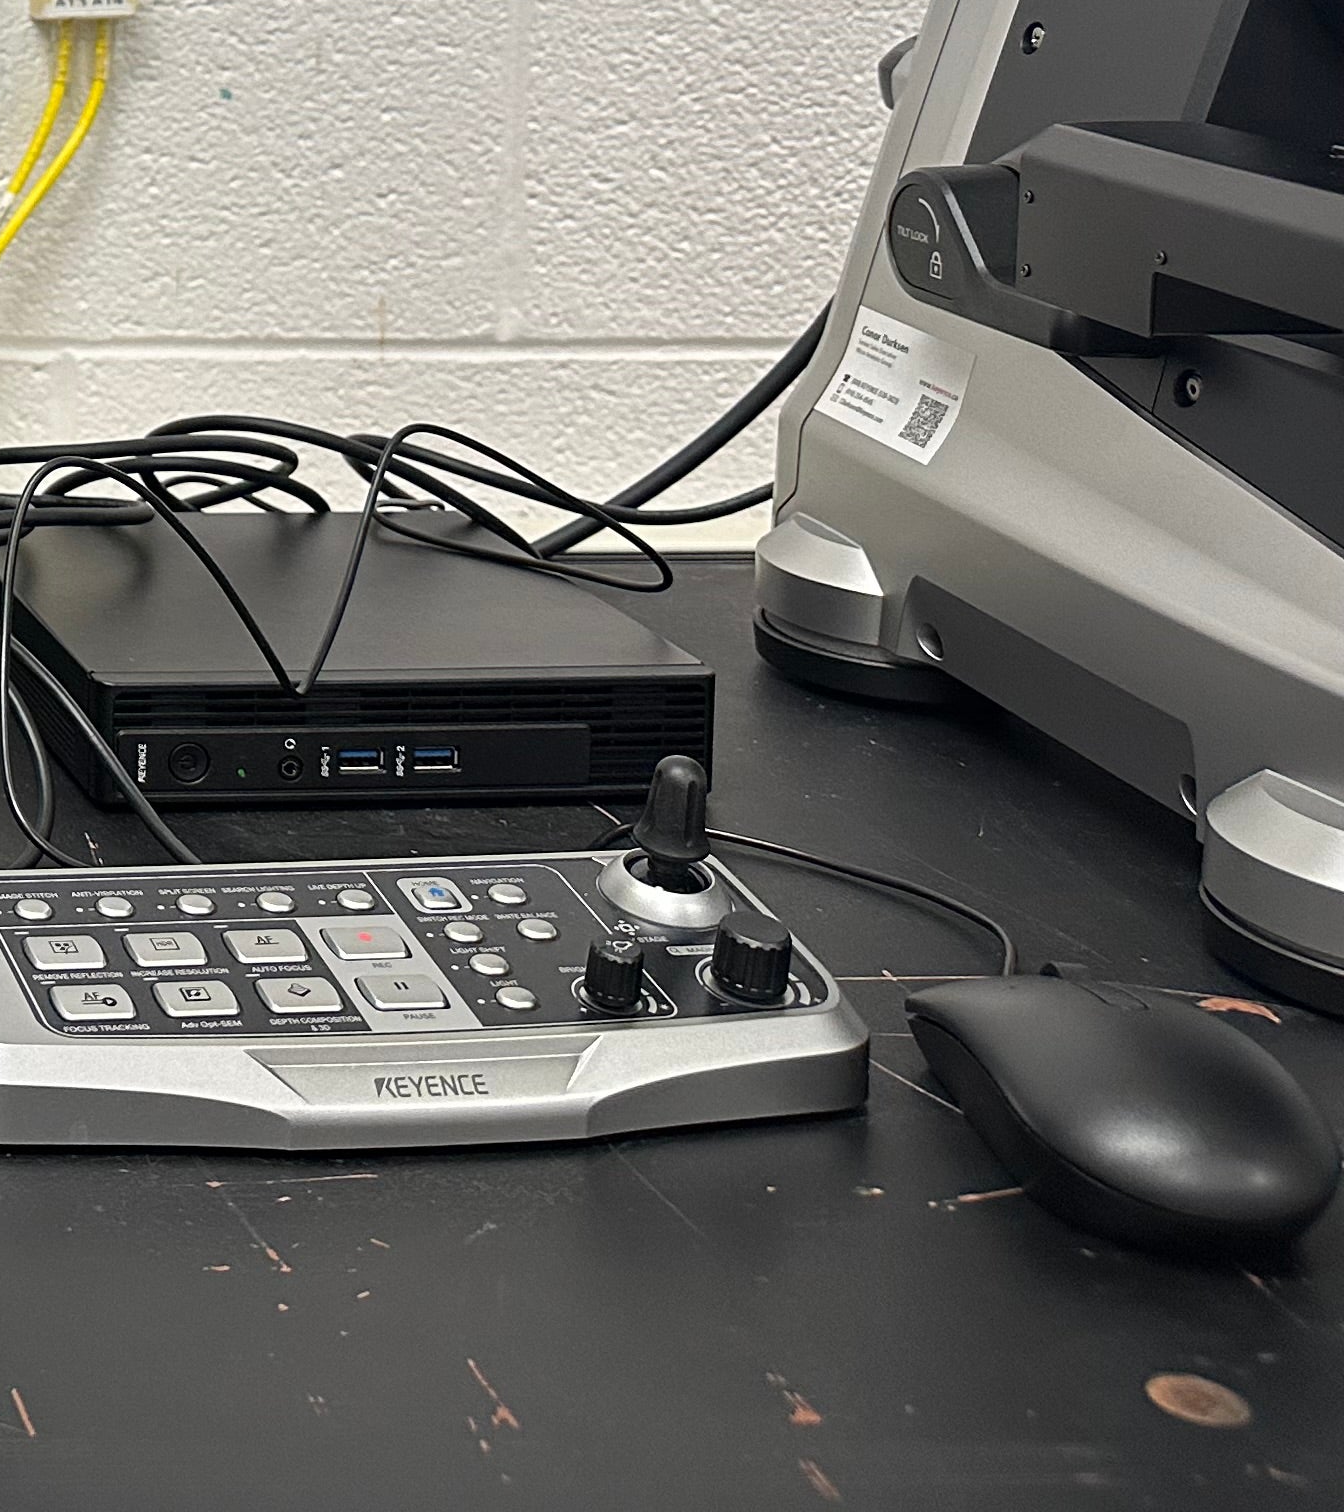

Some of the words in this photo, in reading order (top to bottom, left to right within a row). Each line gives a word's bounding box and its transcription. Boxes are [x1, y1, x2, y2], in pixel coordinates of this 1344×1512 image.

[325, 882, 353, 890] DEPTH
[353, 881, 367, 889] UP
[469, 876, 526, 886] NAVIGATION
[71, 889, 144, 898] ANTI-VIBRATION
[158, 888, 181, 896] SPLIT
[256, 884, 296, 893] LIGHTING
[25, 891, 59, 899] STITCH
[416, 914, 448, 923] SWITCH
[464, 913, 491, 921] MODE
[521, 911, 559, 920] BALANCE
[255, 935, 274, 944] AF
[448, 947, 478, 955] LIGHT
[478, 945, 507, 954] SHIFT
[250, 964, 278, 974] AUTO
[278, 963, 313, 973] FOCUS
[371, 961, 393, 970] REC
[31, 972, 69, 982] REMOVE
[70, 970, 124, 981] REFLECTION
[130, 968, 175, 978] INCREASE
[175, 966, 230, 977] RESOLUTION
[489, 978, 519, 988] LIGHT
[83, 991, 101, 1001] AF
[268, 1017, 300, 1026] DEPTH
[300, 1015, 364, 1025] COMPOSITION
[402, 1012, 437, 1021] PAUSE
[63, 1024, 99, 1034] FOCUS
[99, 1023, 151, 1033] TRACKING
[181, 1020, 200, 1030] Adv
[373, 1073, 490, 1099] KEYENCE
